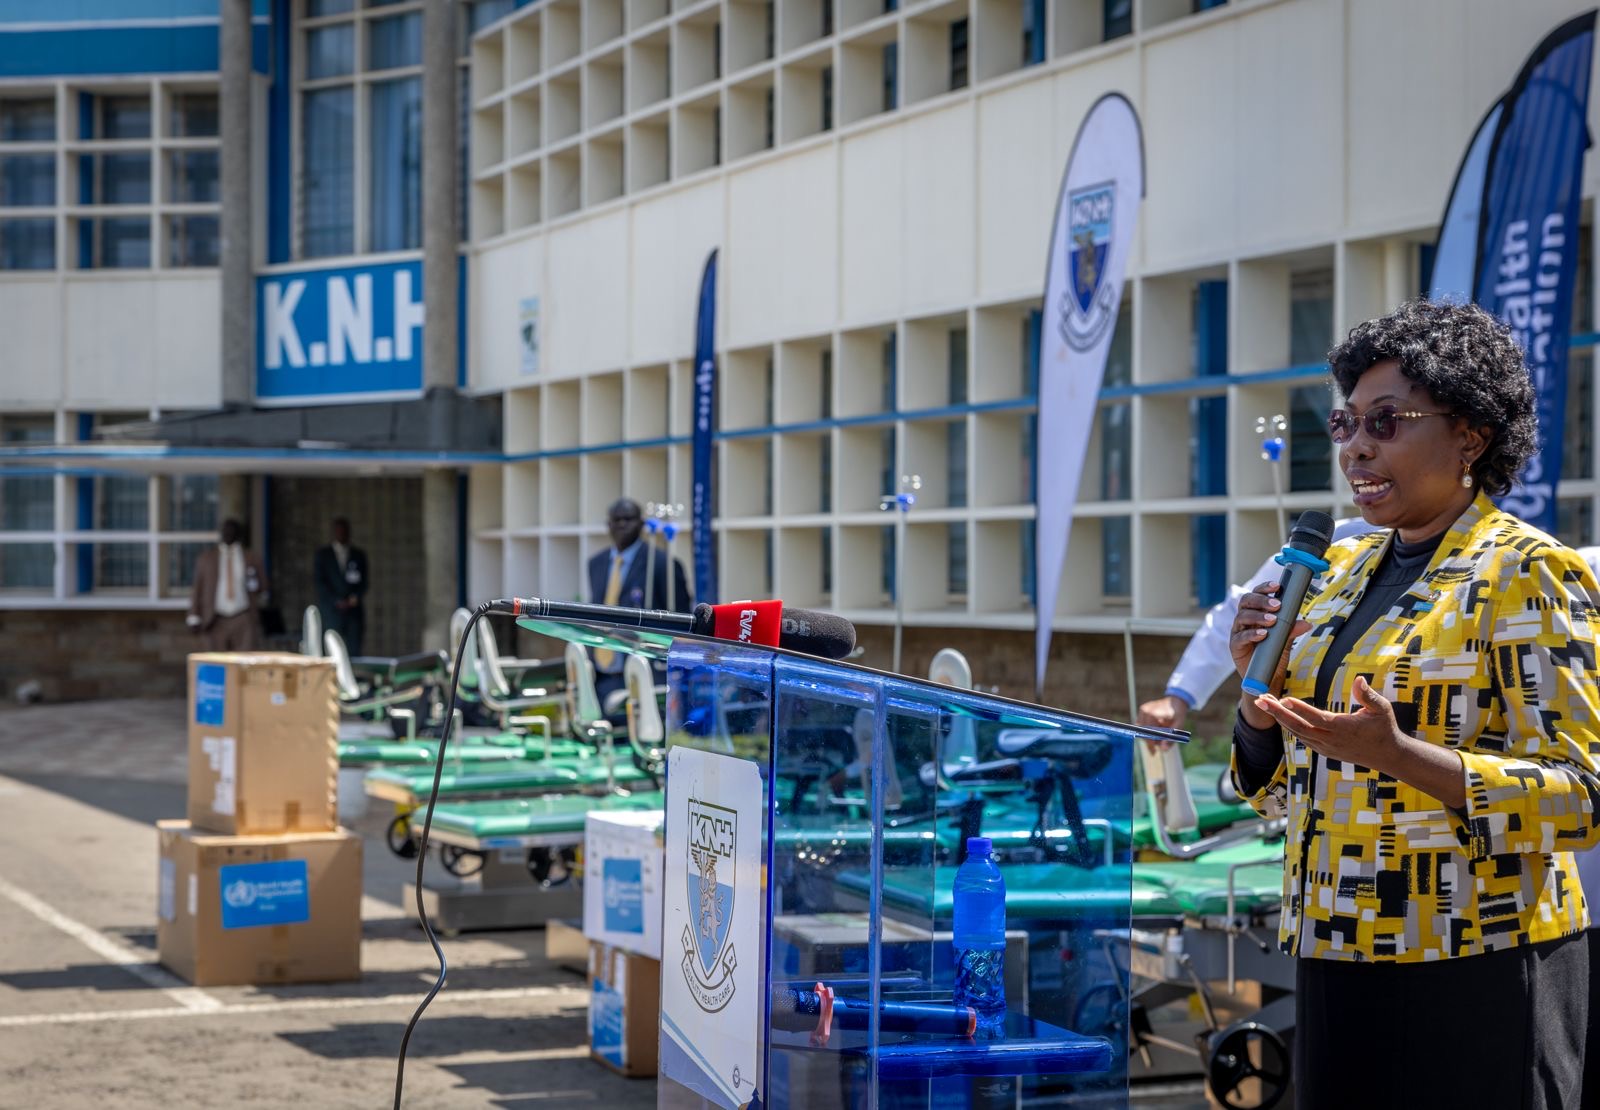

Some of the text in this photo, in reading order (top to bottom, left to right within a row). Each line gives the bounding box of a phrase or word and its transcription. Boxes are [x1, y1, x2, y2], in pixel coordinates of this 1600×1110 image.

[781, 618, 811, 637] DE
[690, 811, 733, 858] KNH
[701, 992, 719, 1006] HEALTH
[719, 984, 731, 1003] CARE
